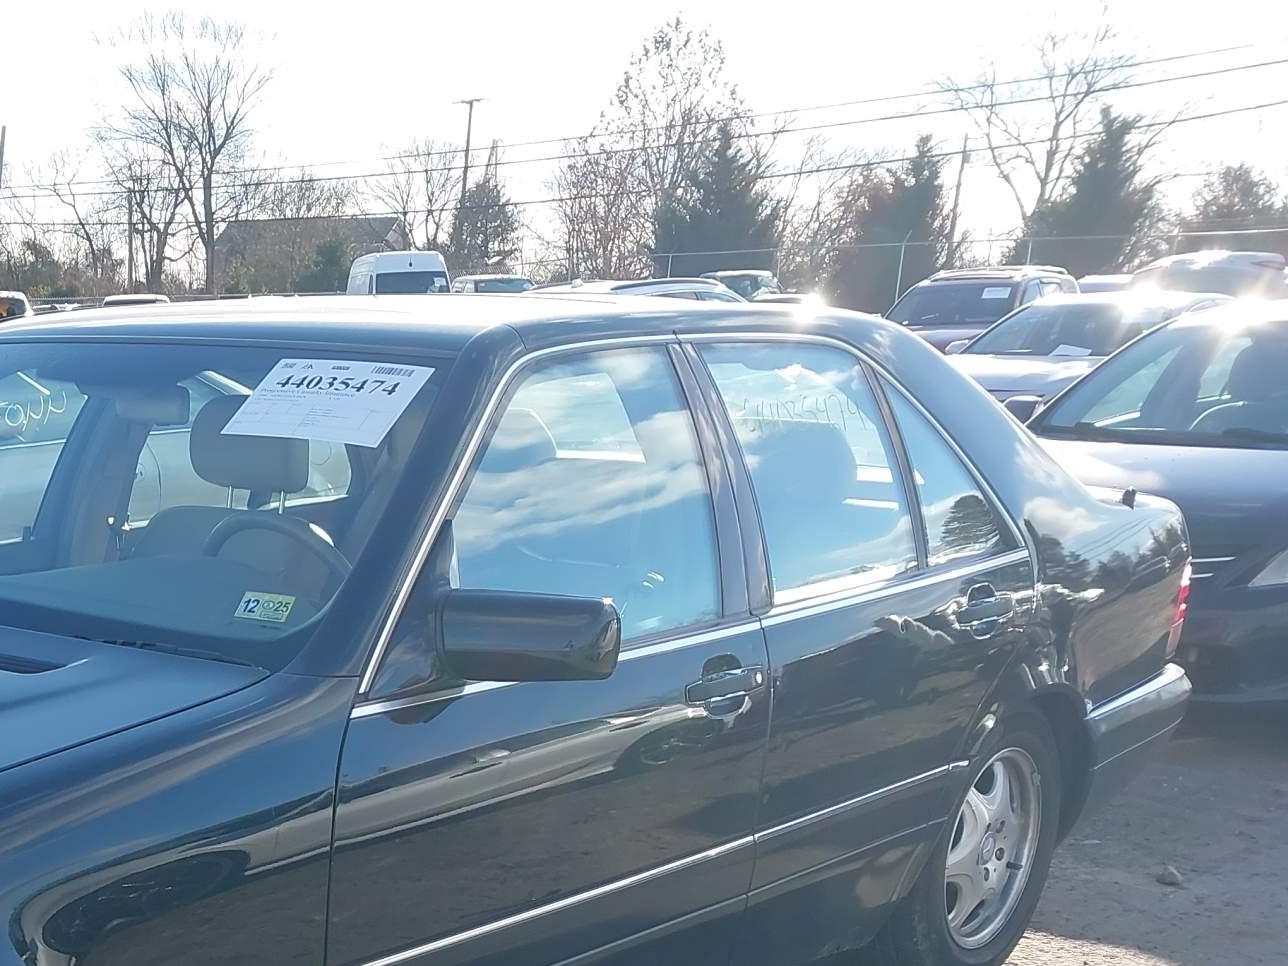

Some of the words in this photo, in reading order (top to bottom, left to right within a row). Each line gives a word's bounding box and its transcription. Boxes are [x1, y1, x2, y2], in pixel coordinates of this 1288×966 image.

[276, 374, 401, 396] 44035474
[242, 598, 260, 614] 12
[273, 600, 291, 613] 25
